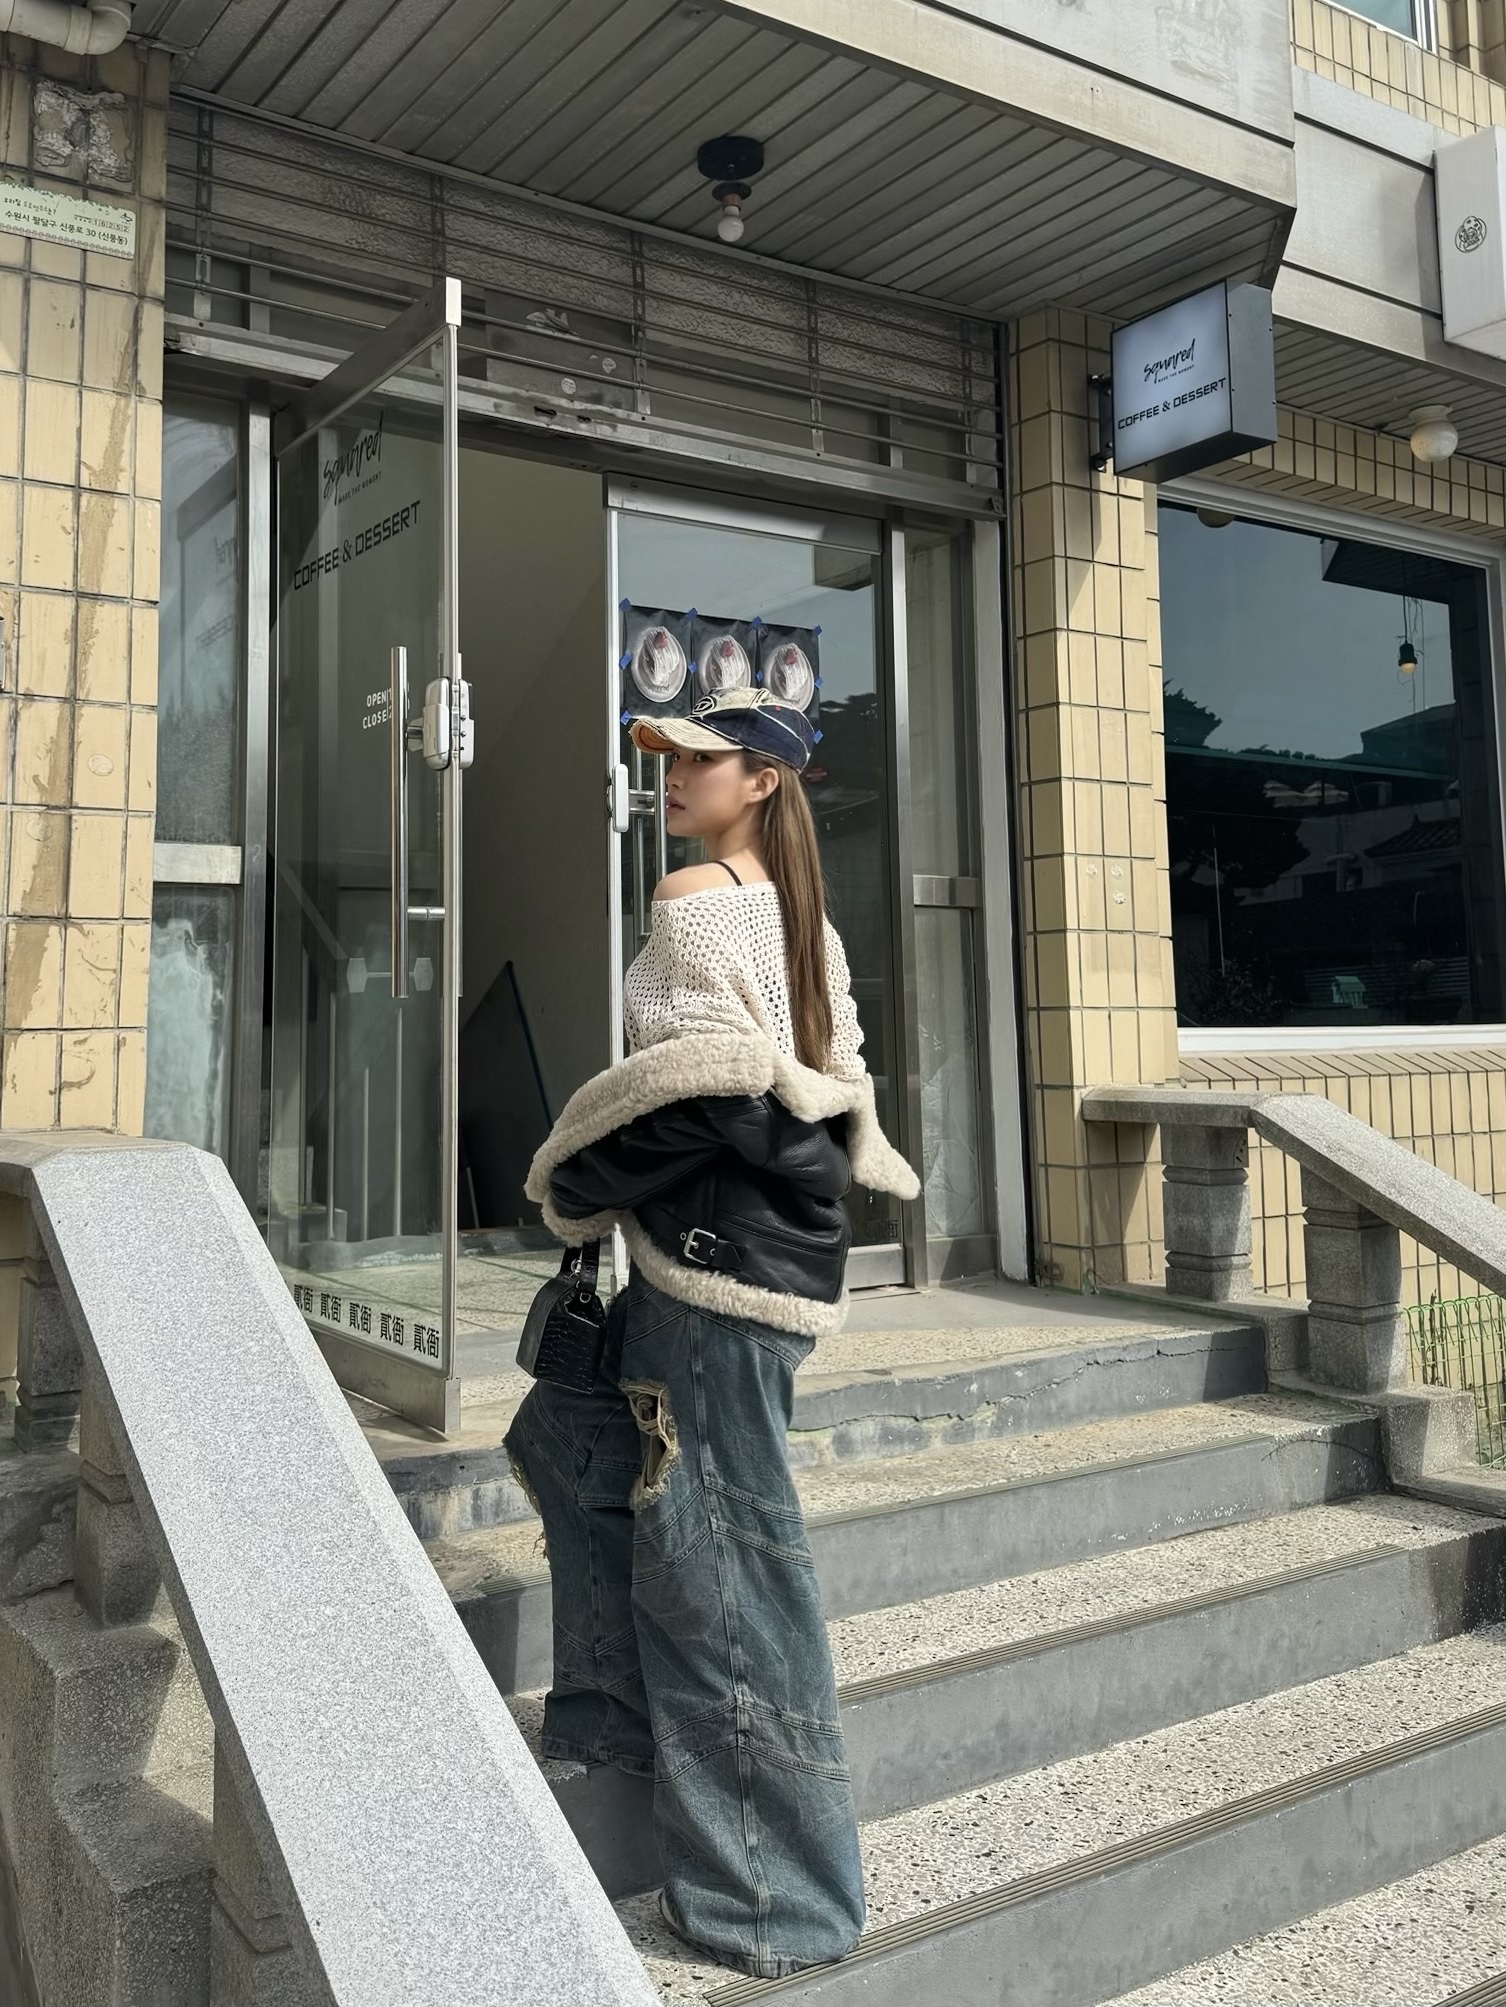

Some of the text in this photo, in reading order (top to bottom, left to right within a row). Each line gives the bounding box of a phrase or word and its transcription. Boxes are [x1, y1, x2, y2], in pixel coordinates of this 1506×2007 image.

[5, 210, 128, 246] 수원시 팔달구 신풍로 30 (신풍동)
[1143, 338, 1196, 384] squared
[1118, 377, 1226, 430] COFFEE & DESSERT
[323, 409, 384, 506] squared
[294, 499, 421, 591] COFFEE & DESSERT
[362, 709, 387, 730] CLOSE
[366, 690, 387, 707] OPEN
